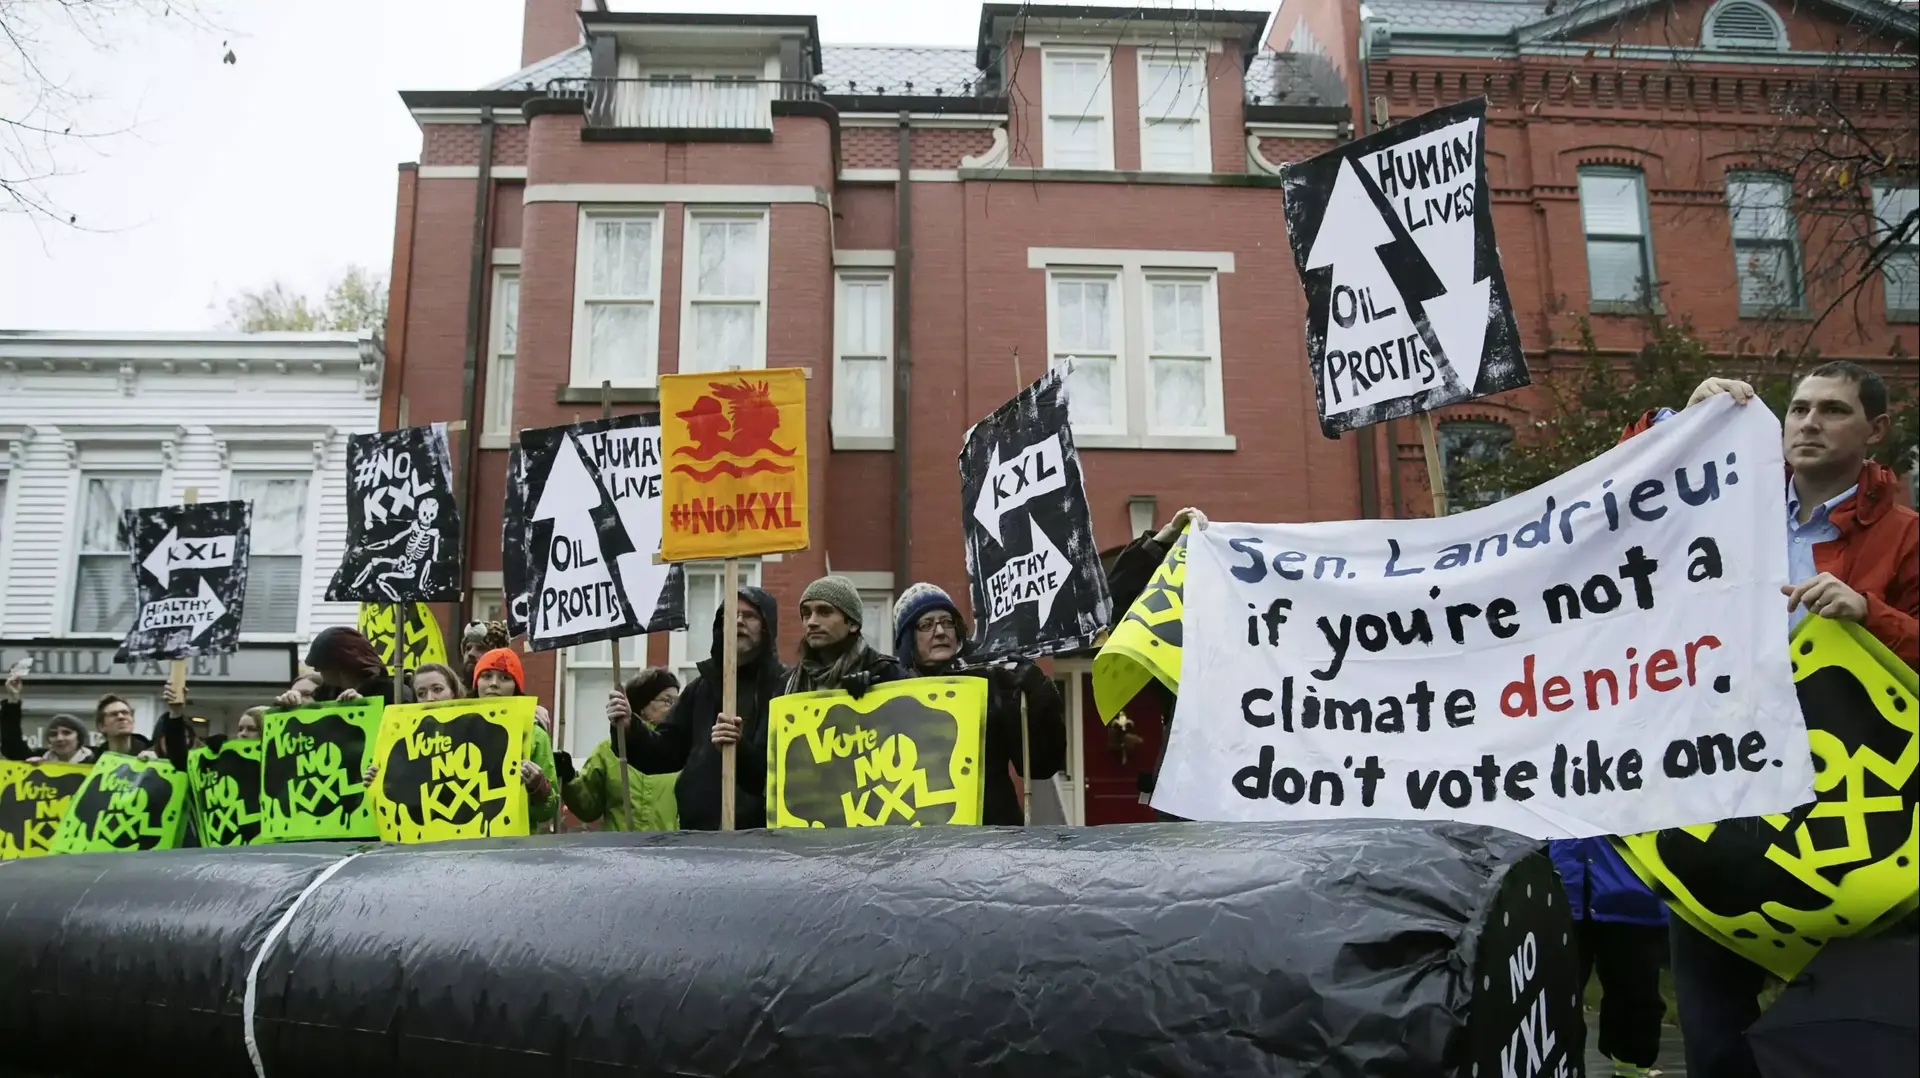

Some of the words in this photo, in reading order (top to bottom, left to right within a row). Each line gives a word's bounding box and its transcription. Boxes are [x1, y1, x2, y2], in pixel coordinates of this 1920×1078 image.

[1377, 131, 1474, 198] HUMAN
[1404, 184, 1475, 232] LIVES
[1332, 285, 1397, 329] OIL
[1327, 333, 1435, 405] PROFITS
[354, 448, 411, 491] #NO
[592, 433, 661, 470] HUMA
[363, 468, 434, 530] KXL
[610, 472, 662, 501] LIVE
[992, 451, 1057, 510] KXL
[1229, 538, 1356, 583] Sen.
[1384, 452, 1739, 577] Landrieu:
[167, 542, 227, 565] KXL
[551, 535, 598, 571] OIL
[991, 550, 1049, 598] HELTHY
[144, 611, 215, 628] CLIMATE
[542, 581, 620, 631] PROFITS
[1248, 598, 1293, 647] if
[1310, 585, 1521, 681] you're
[1542, 545, 1658, 624] not
[1687, 536, 1723, 582] a
[27, 650, 111, 674] HILL
[1241, 675, 1477, 733] climate
[1500, 635, 1731, 718] denier.
[274, 732, 315, 759] Vote
[296, 742, 342, 777] NO
[405, 730, 452, 761] Vote
[431, 741, 482, 781] NO
[805, 725, 878, 764] Vote
[854, 733, 918, 788] NO
[14, 780, 58, 802] Vote
[205, 774, 239, 810] NO
[1231, 745, 1386, 807] don't
[1405, 755, 1539, 810] vote
[1550, 740, 1643, 799] like
[1663, 730, 1783, 779] one.
[108, 786, 149, 815] NO
[288, 767, 367, 818] KXL
[420, 771, 508, 826] KXL
[840, 767, 956, 827] KXL
[92, 808, 164, 845] KXL
[204, 798, 262, 843] KXL
[1509, 931, 1537, 1004] NO
